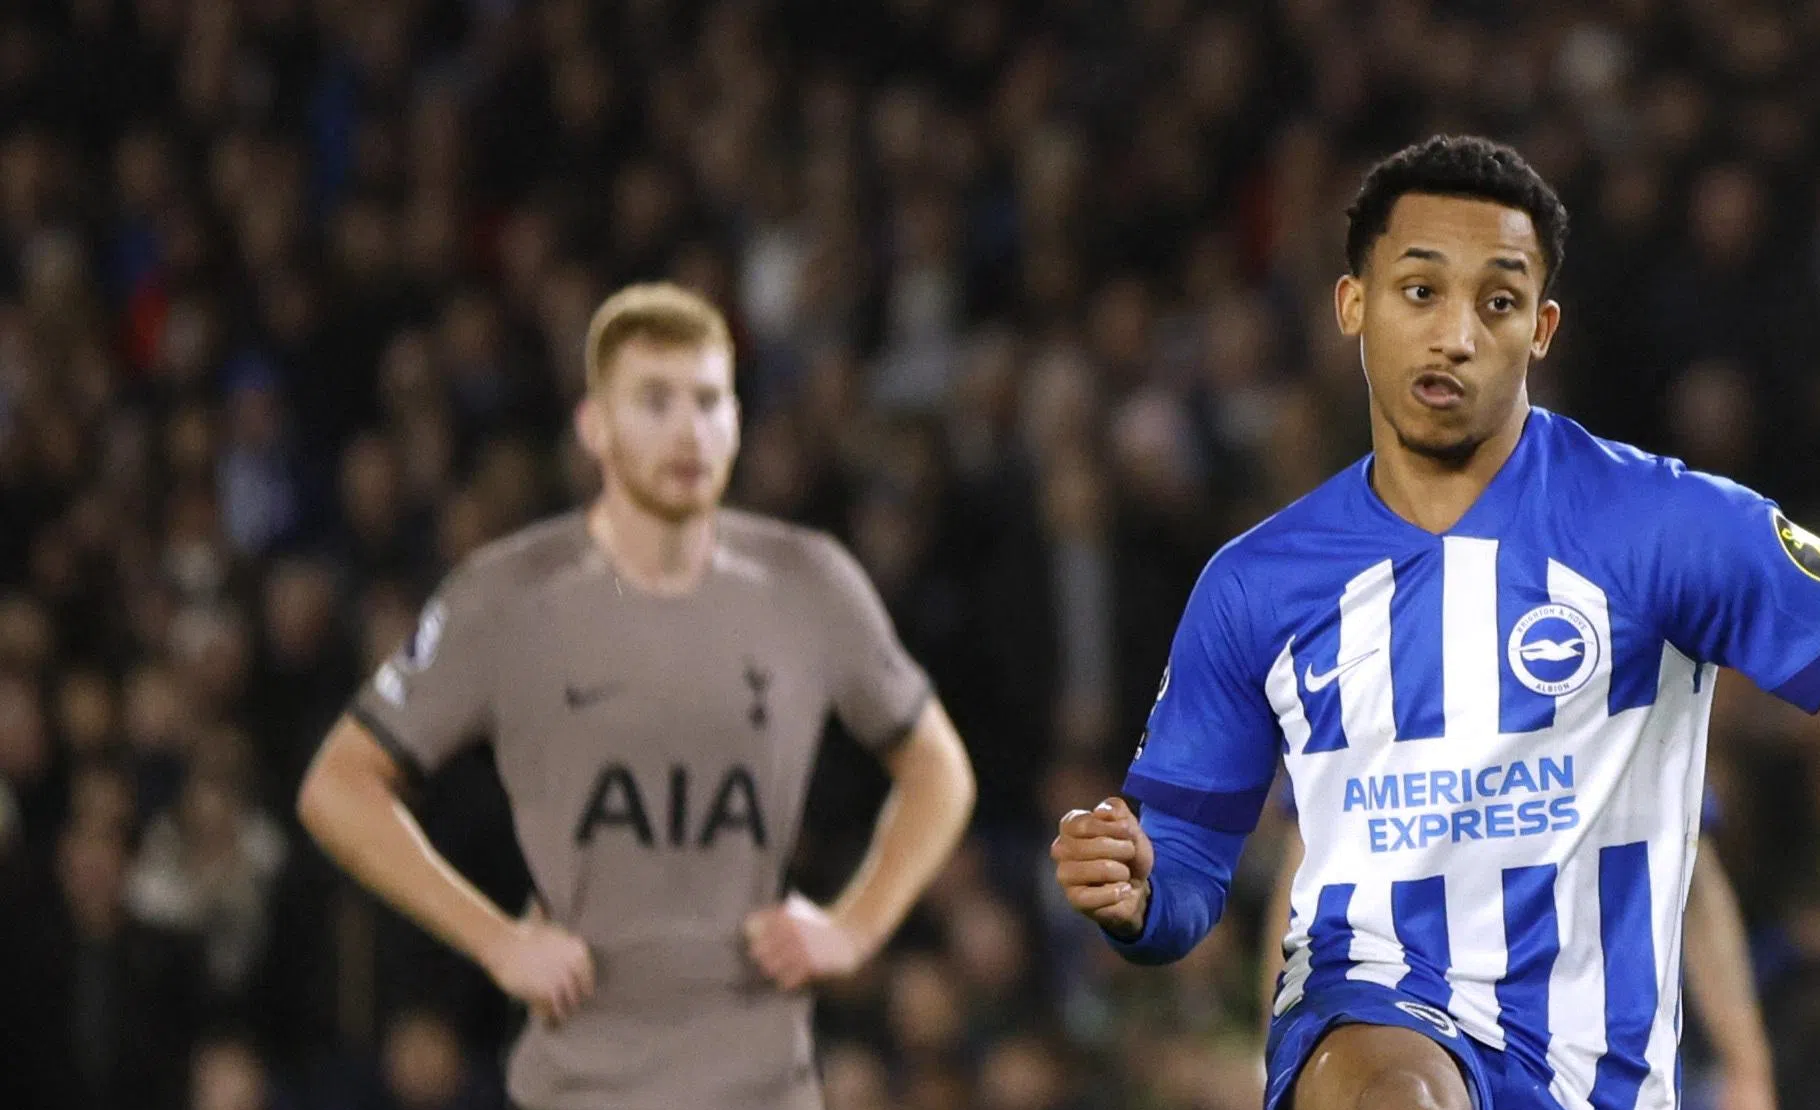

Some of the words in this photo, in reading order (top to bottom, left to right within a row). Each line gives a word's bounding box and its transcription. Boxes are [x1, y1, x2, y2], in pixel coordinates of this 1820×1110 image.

[1517, 608, 1554, 632] BRIGHTON
[1568, 613, 1587, 631] HOVE
[1536, 682, 1570, 692] ALBION
[575, 762, 767, 848] AIA
[1343, 755, 1575, 812] AMERICAN
[1368, 795, 1581, 853] EXPRESS
